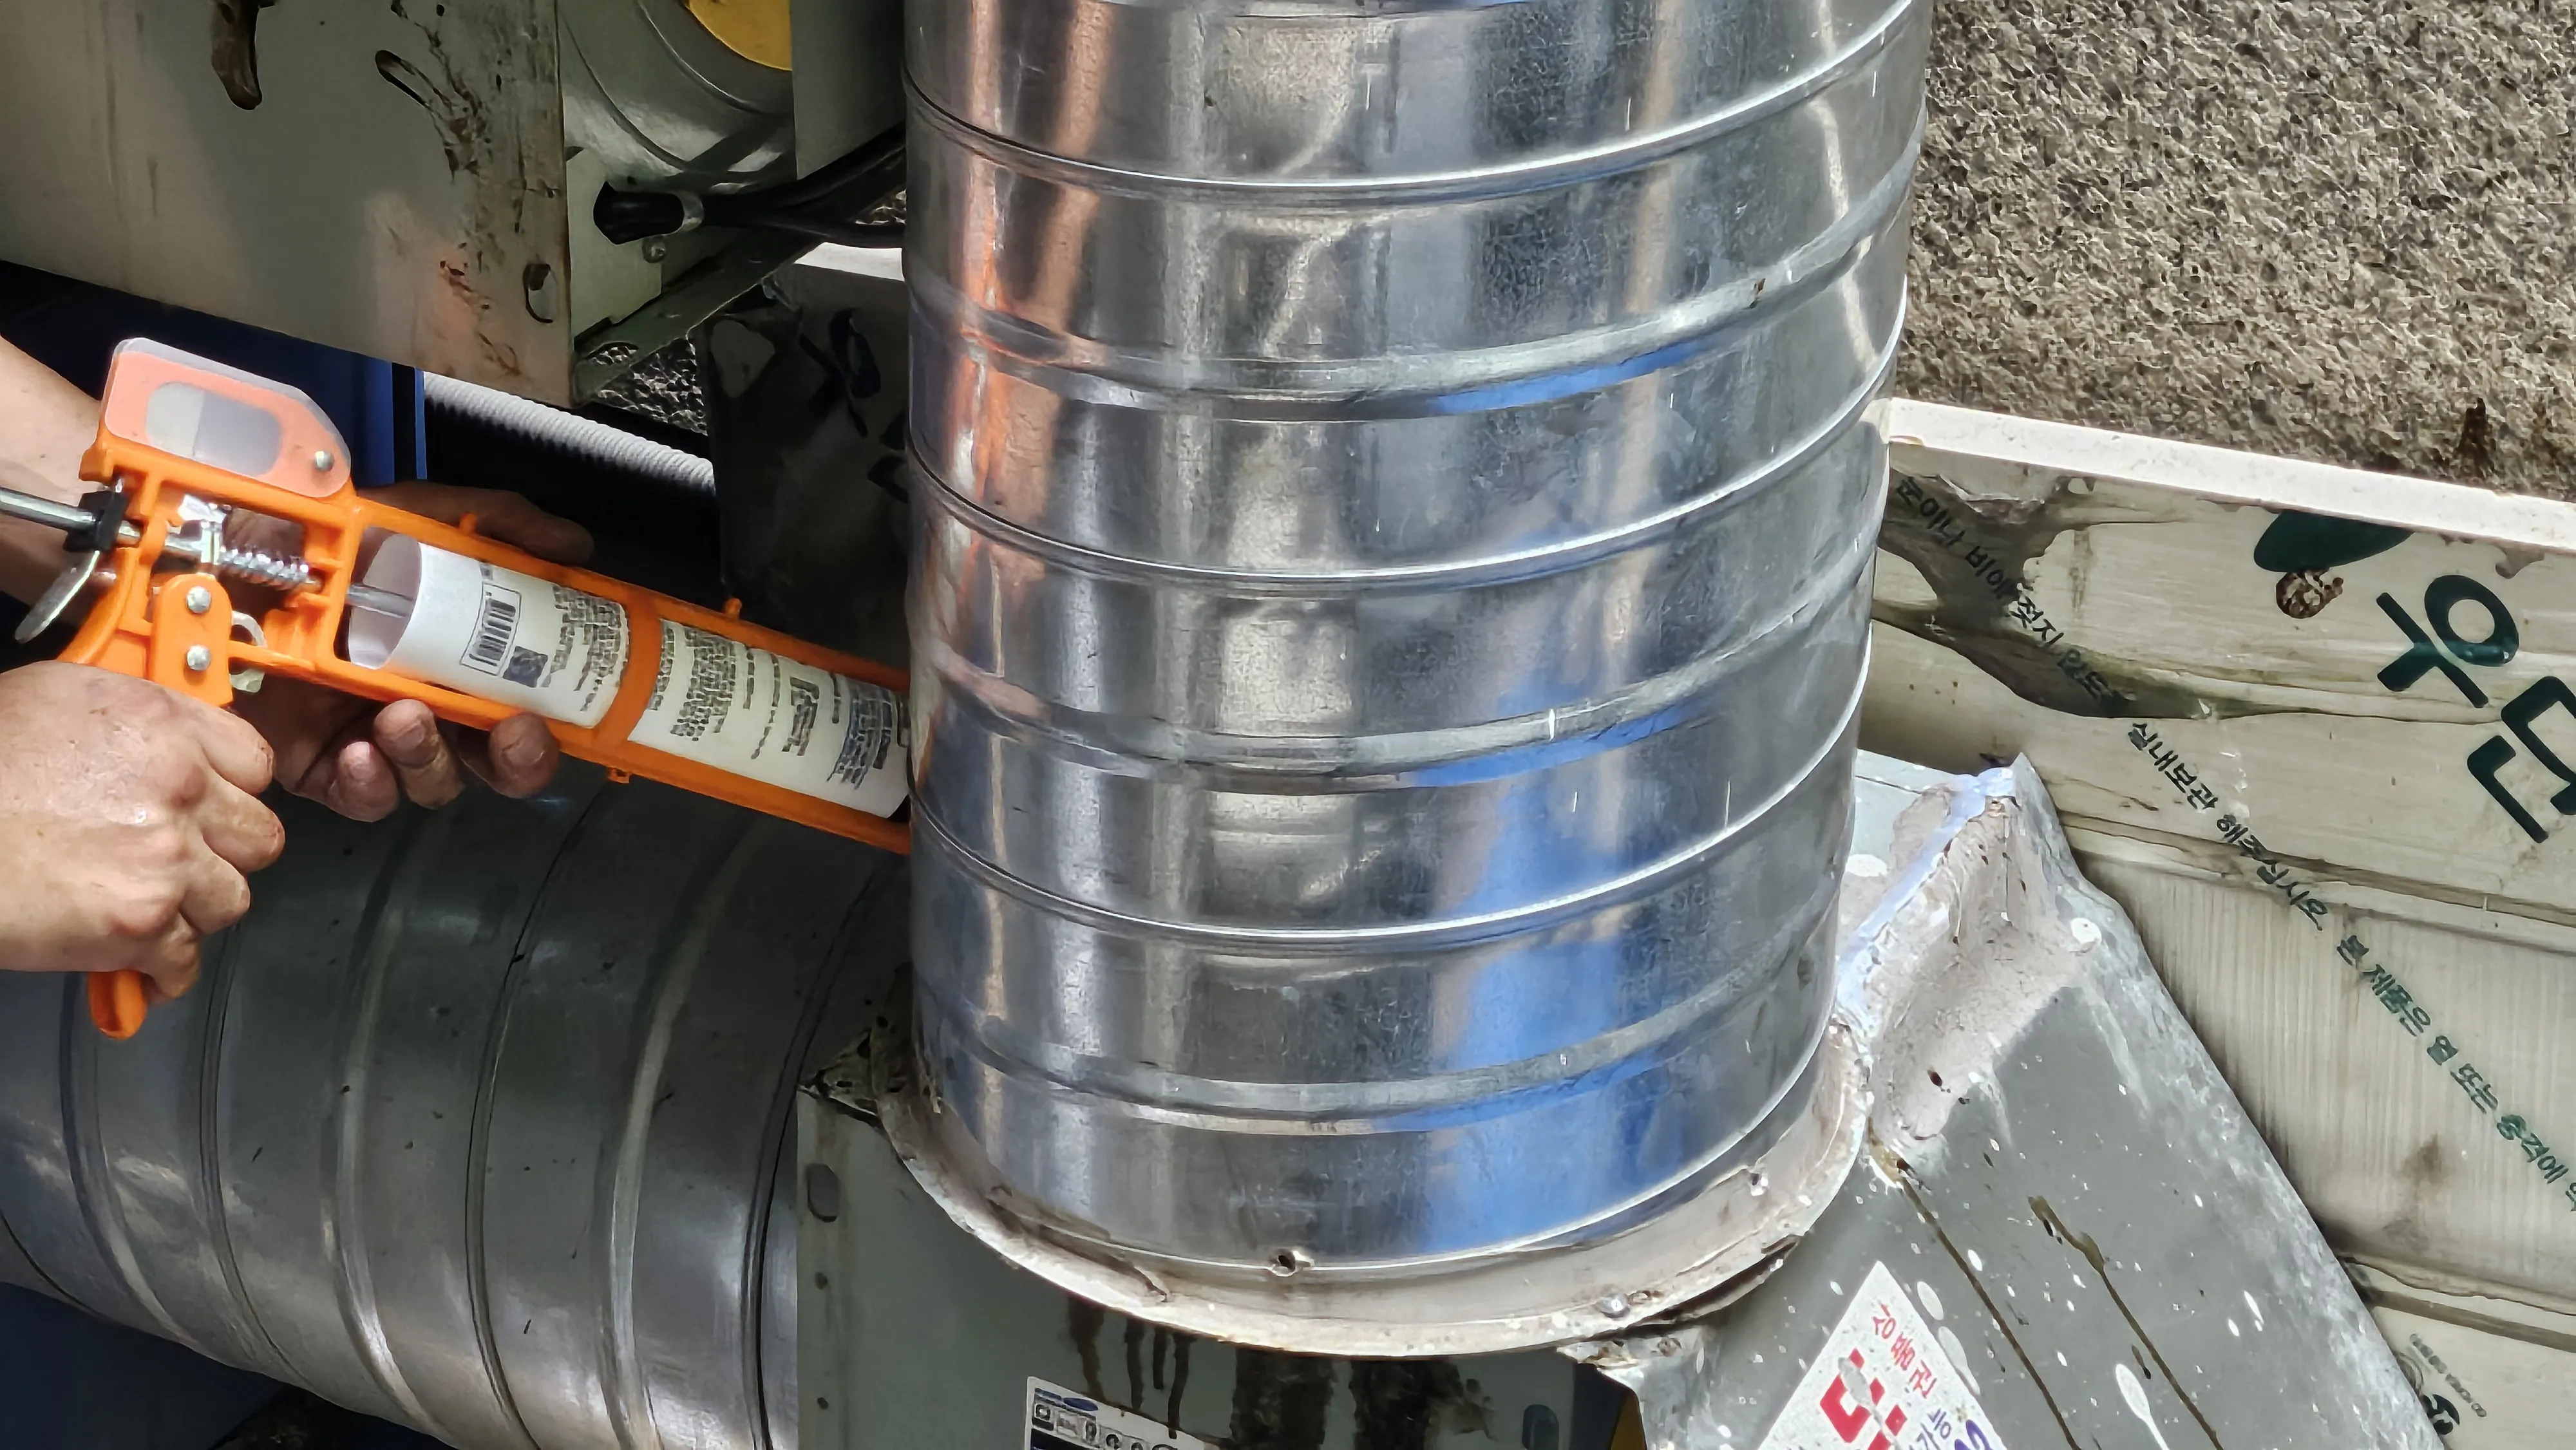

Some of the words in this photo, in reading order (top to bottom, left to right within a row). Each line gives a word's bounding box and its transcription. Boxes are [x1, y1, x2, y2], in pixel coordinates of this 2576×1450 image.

[2007, 595, 2065, 646] 젖지
[2127, 722, 2219, 810] 실내보관
[2336, 934, 2370, 966] 본
[2362, 963, 2432, 1037] 제품은
[2426, 1035, 2459, 1066] 열
[2450, 1062, 2499, 1114] 또는
[2496, 1114, 2570, 1185] 충격에
